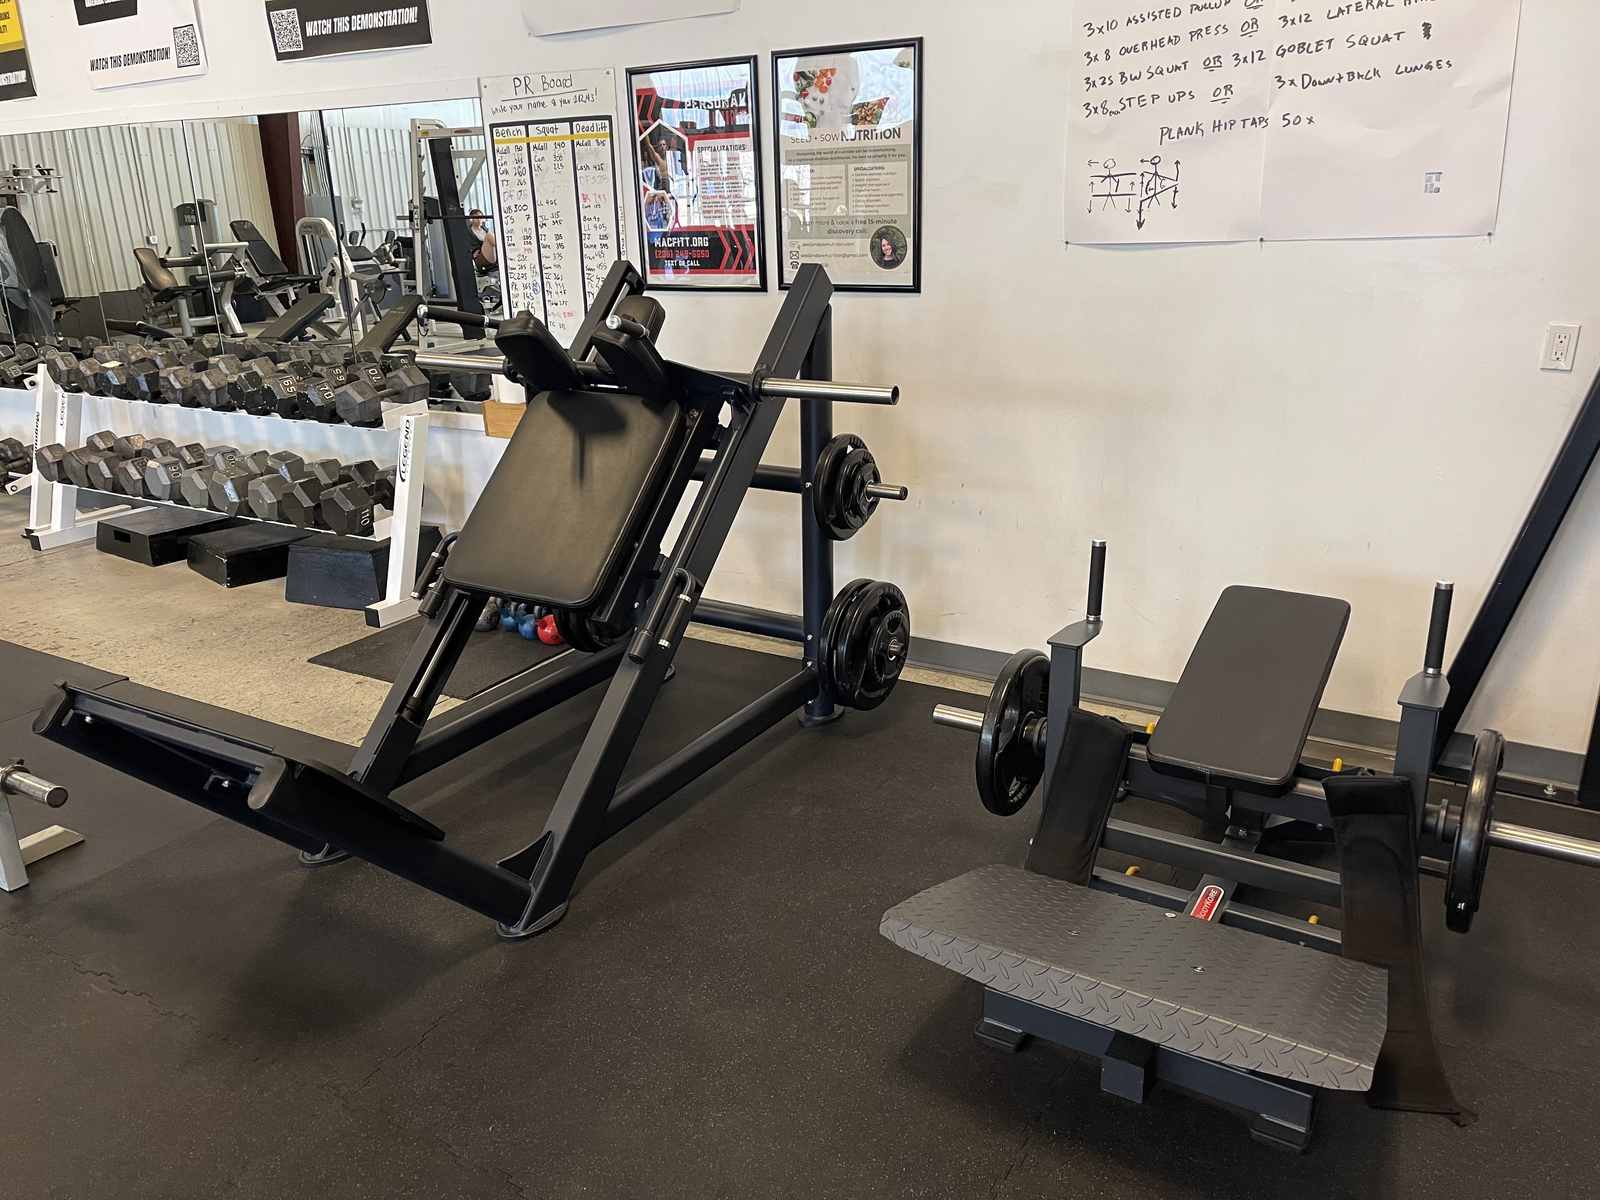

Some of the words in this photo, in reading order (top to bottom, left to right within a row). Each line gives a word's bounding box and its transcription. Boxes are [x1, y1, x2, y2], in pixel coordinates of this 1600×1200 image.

[306, 18, 332, 37] WATCH
[333, 16, 350, 33] THIS
[351, 7, 418, 31] DEMONSTRATION!
[1126, 7, 1182, 27] ASSISTED
[1119, 35, 1181, 56] OVERHEAD
[1189, 24, 1229, 42] PRESS
[1240, 17, 1259, 35] OR
[1279, 13, 1312, 28] 3x12
[1326, 0, 1395, 20] LATERAL
[90, 56, 109, 71] WATCH
[110, 55, 122, 69] THIS
[123, 47, 171, 66] DEMONSTRATION!
[1119, 71, 1142, 85] BW
[1146, 60, 1189, 80] SQUAT
[1203, 55, 1223, 70] OR
[1232, 50, 1266, 67] 3x12
[1275, 38, 1335, 58] GOBLET
[1345, 31, 1406, 49] SQUAT
[1395, 59, 1452, 76] LUNGES
[512, 76, 534, 96] PR
[541, 74, 573, 91] Board
[1119, 93, 1160, 112] STEP
[1168, 90, 1195, 104] UPS
[1210, 84, 1234, 101] OR
[495, 128, 522, 138] Bench
[536, 124, 559, 136] Squat
[575, 122, 608, 133] Deadlift
[1159, 121, 1205, 145] PLANK
[1212, 119, 1236, 133] HIP
[1241, 116, 1269, 129] TAPS
[283, 379, 297, 393] 65
[320, 383, 335, 400] 70
[361, 508, 370, 526] 110
